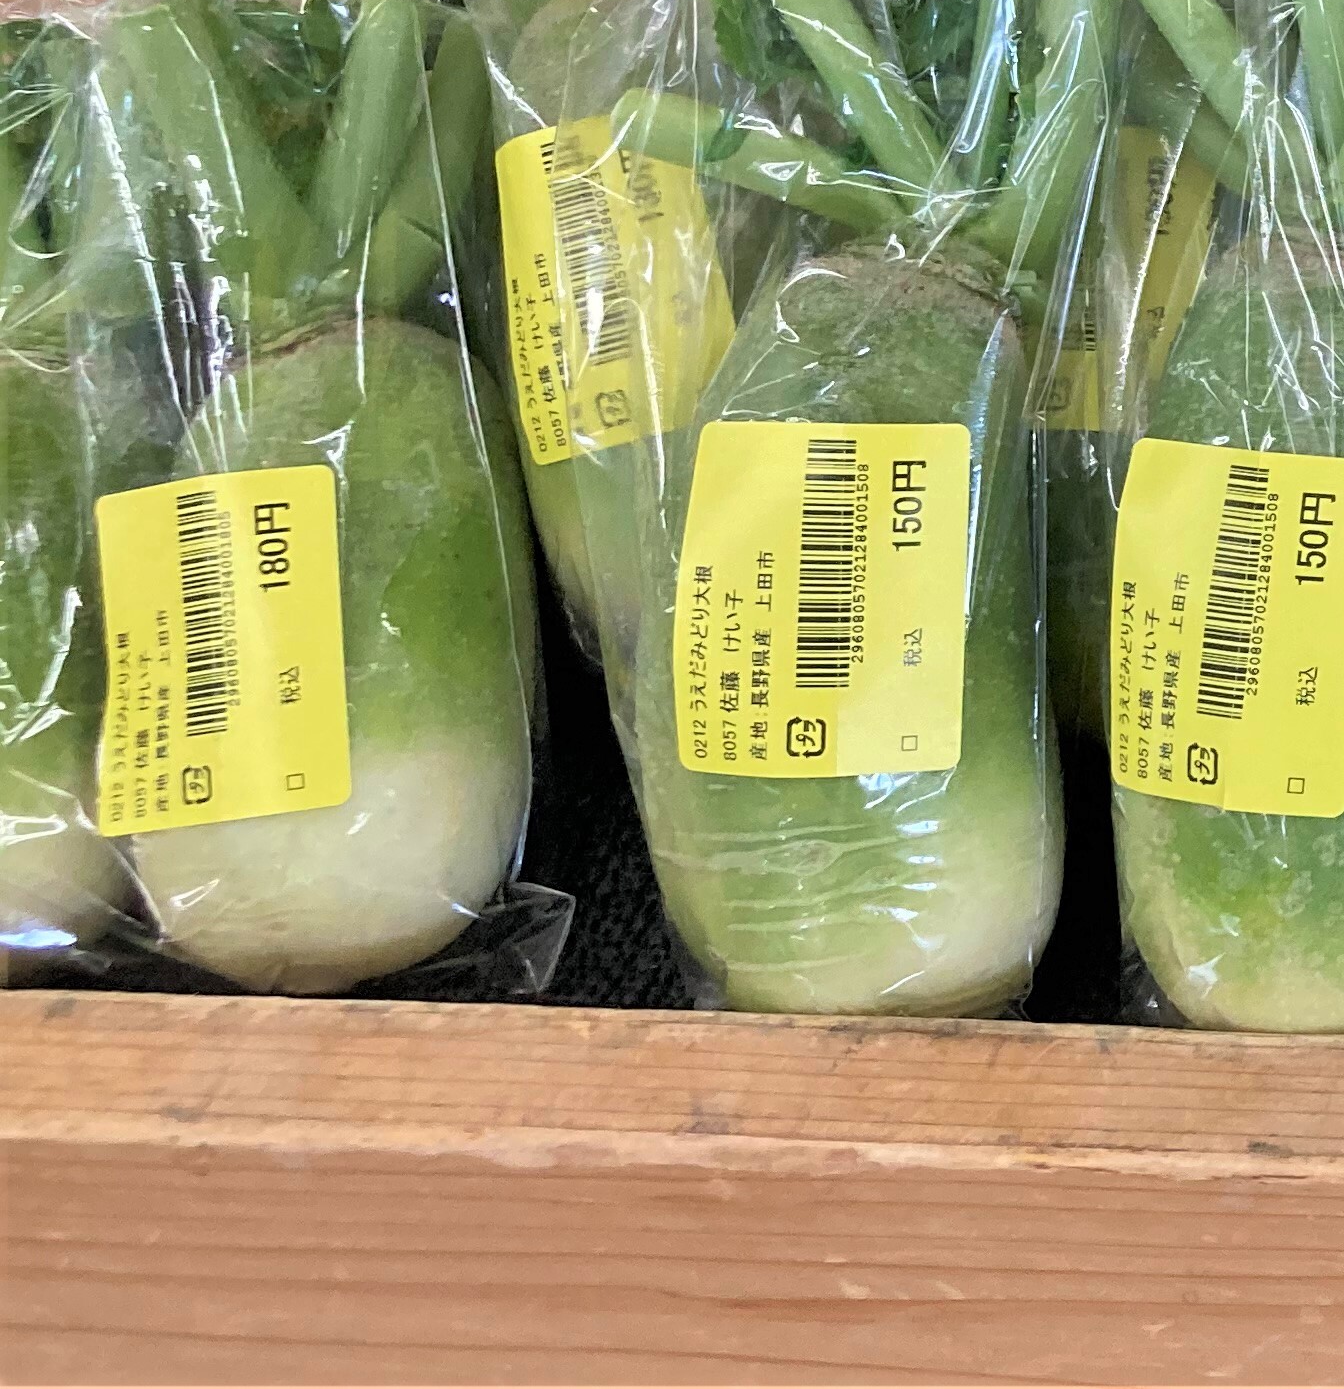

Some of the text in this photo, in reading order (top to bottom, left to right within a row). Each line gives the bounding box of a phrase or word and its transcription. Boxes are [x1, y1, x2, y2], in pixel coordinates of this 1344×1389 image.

[533, 252, 555, 305] 上田市
[524, 296, 544, 350] けい子
[537, 364, 557, 403] 佐藤
[530, 415, 548, 453] 0212
[547, 409, 567, 447] 8057
[891, 459, 926, 551] 150円
[253, 502, 290, 590] 180円
[850, 463, 869, 663] 29608057021284001508
[1294, 491, 1336, 585] 150円
[754, 550, 775, 611] 上田市
[1167, 572, 1190, 634] 上田市
[1244, 492, 1279, 695] 29608057021284001508
[155, 609, 170, 662] 上田市
[690, 565, 712, 759] 0212 うえだみどり大根
[902, 627, 923, 667] 税込
[278, 665, 301, 704] 税込
[720, 589, 743, 761] 8057 佐藤 けい子
[1118, 580, 1136, 773] 0212 うえだみどり大根
[1136, 607, 1160, 779] 8057 佐藤 けい子
[1294, 666, 1318, 706] 税込
[133, 653, 152, 818] 8057 佐藤 けい子
